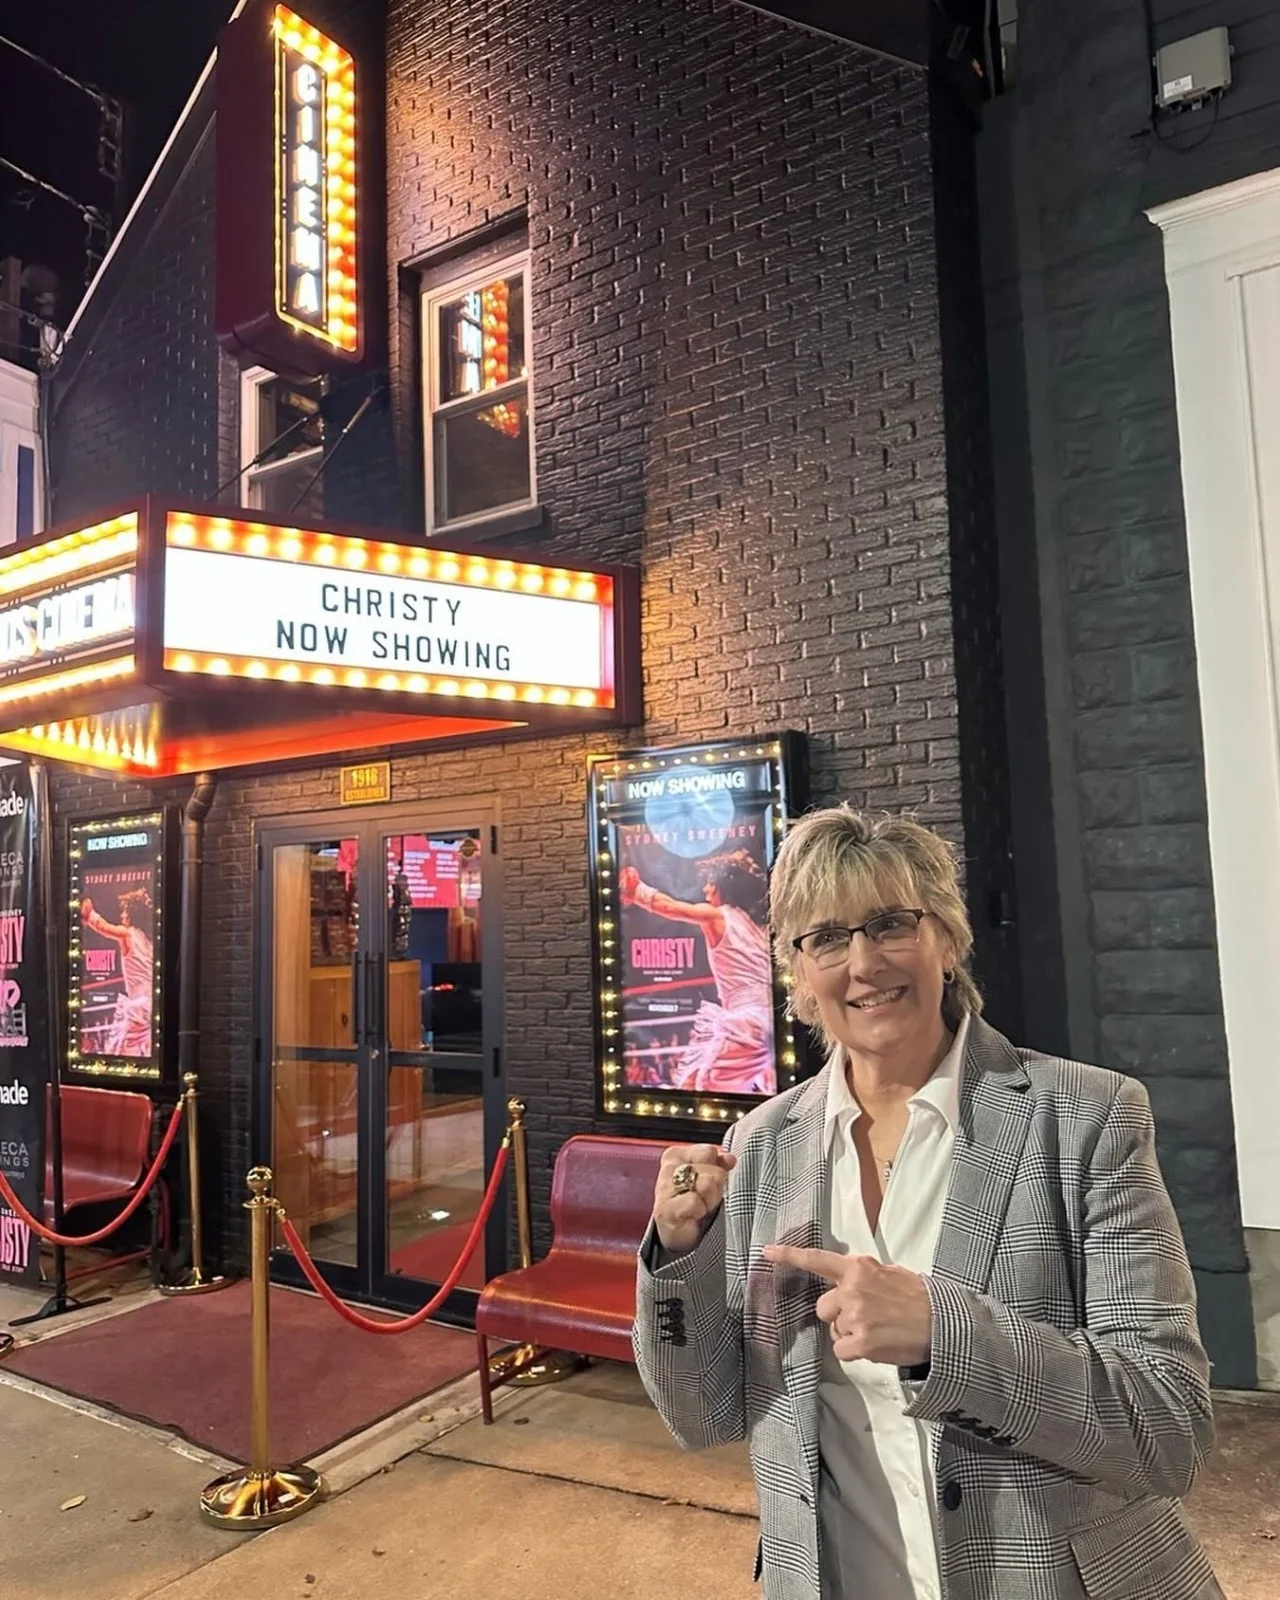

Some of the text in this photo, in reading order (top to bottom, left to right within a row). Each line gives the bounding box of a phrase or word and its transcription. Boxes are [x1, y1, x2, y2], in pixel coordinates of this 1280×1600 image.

[290, 62, 320, 315] CINEMA
[322, 583, 461, 626] CHRISTY
[276, 619, 511, 671] NOW SHOWING
[628, 771, 746, 799] NOW SHOWING
[87, 833, 148, 851] NOW SHOWING
[625, 825, 757, 846] SYDNEY SWEENEY
[632, 937, 695, 968] CHRISTY
[0, 1079, 29, 1105] ade
